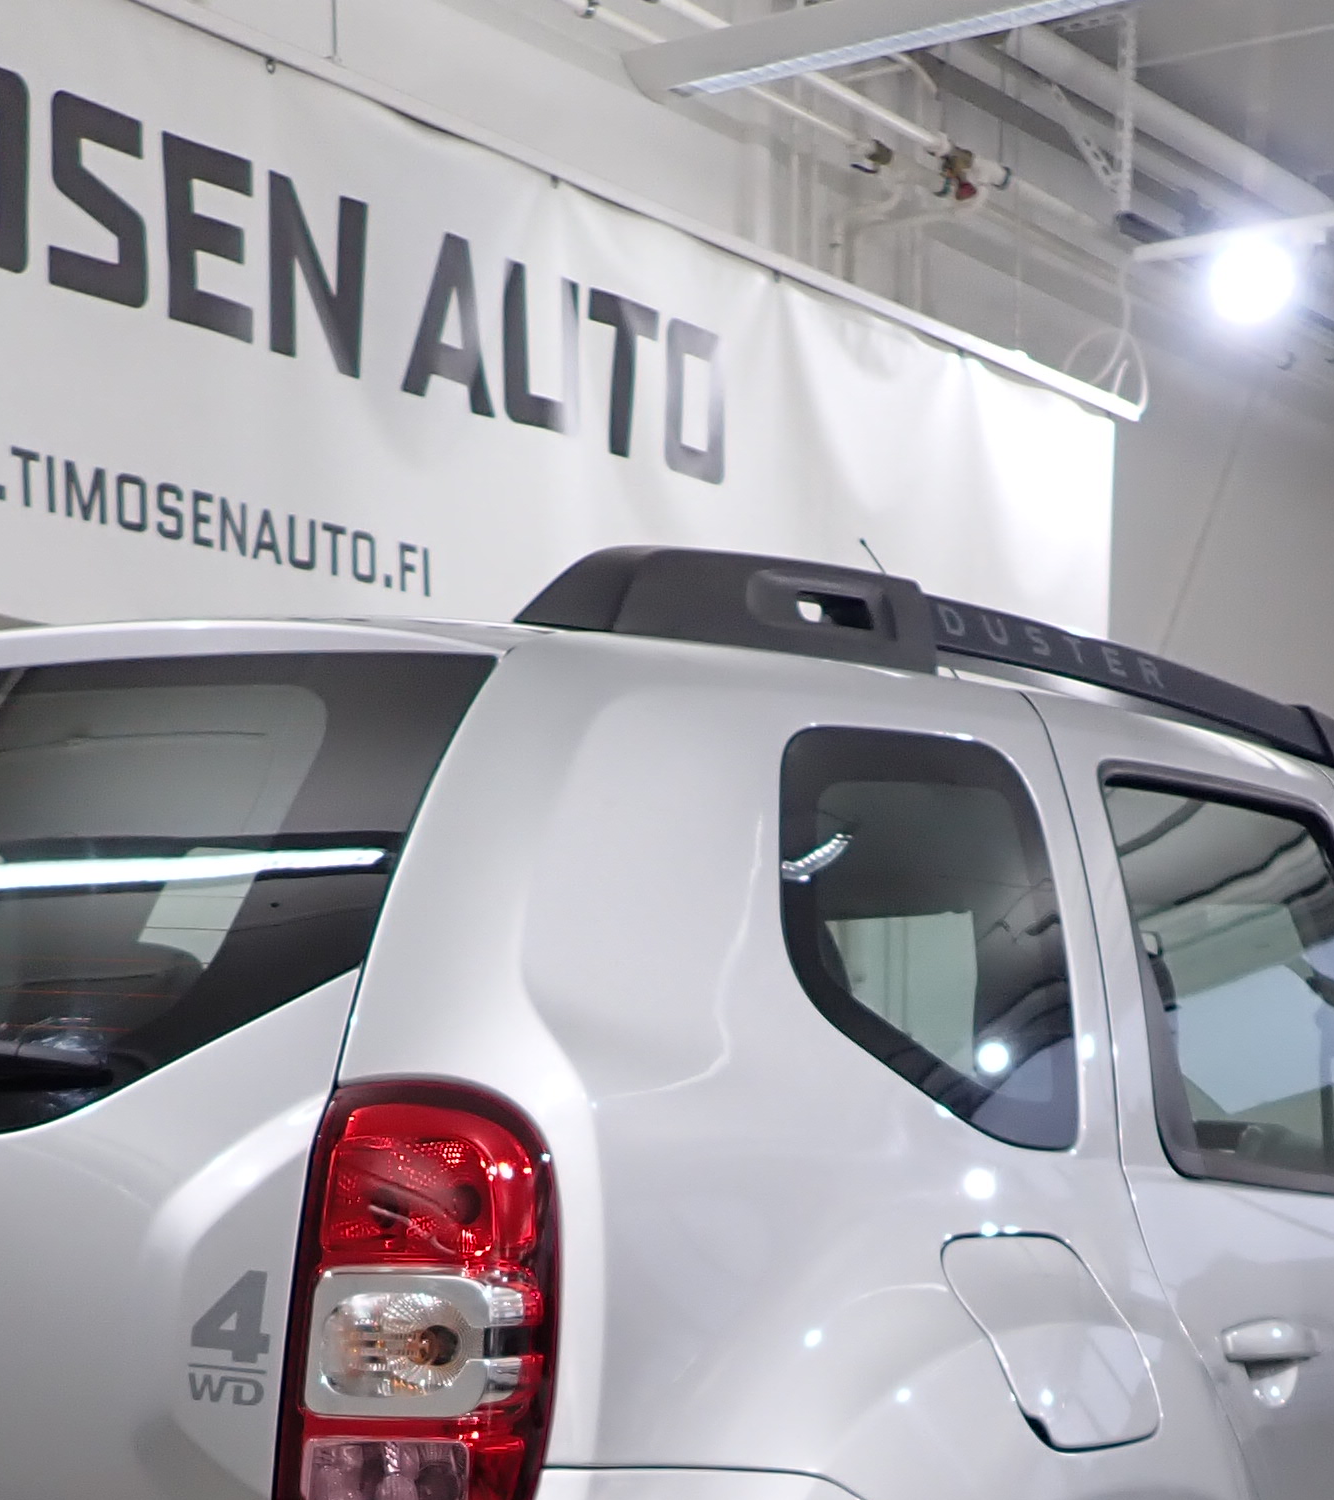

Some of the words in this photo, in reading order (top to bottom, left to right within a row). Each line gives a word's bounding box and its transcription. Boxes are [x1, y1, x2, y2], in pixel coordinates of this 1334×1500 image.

[401, 232, 725, 485] AUTO
[937, 603, 1165, 689] DUSTER
[190, 1269, 271, 1364] 4
